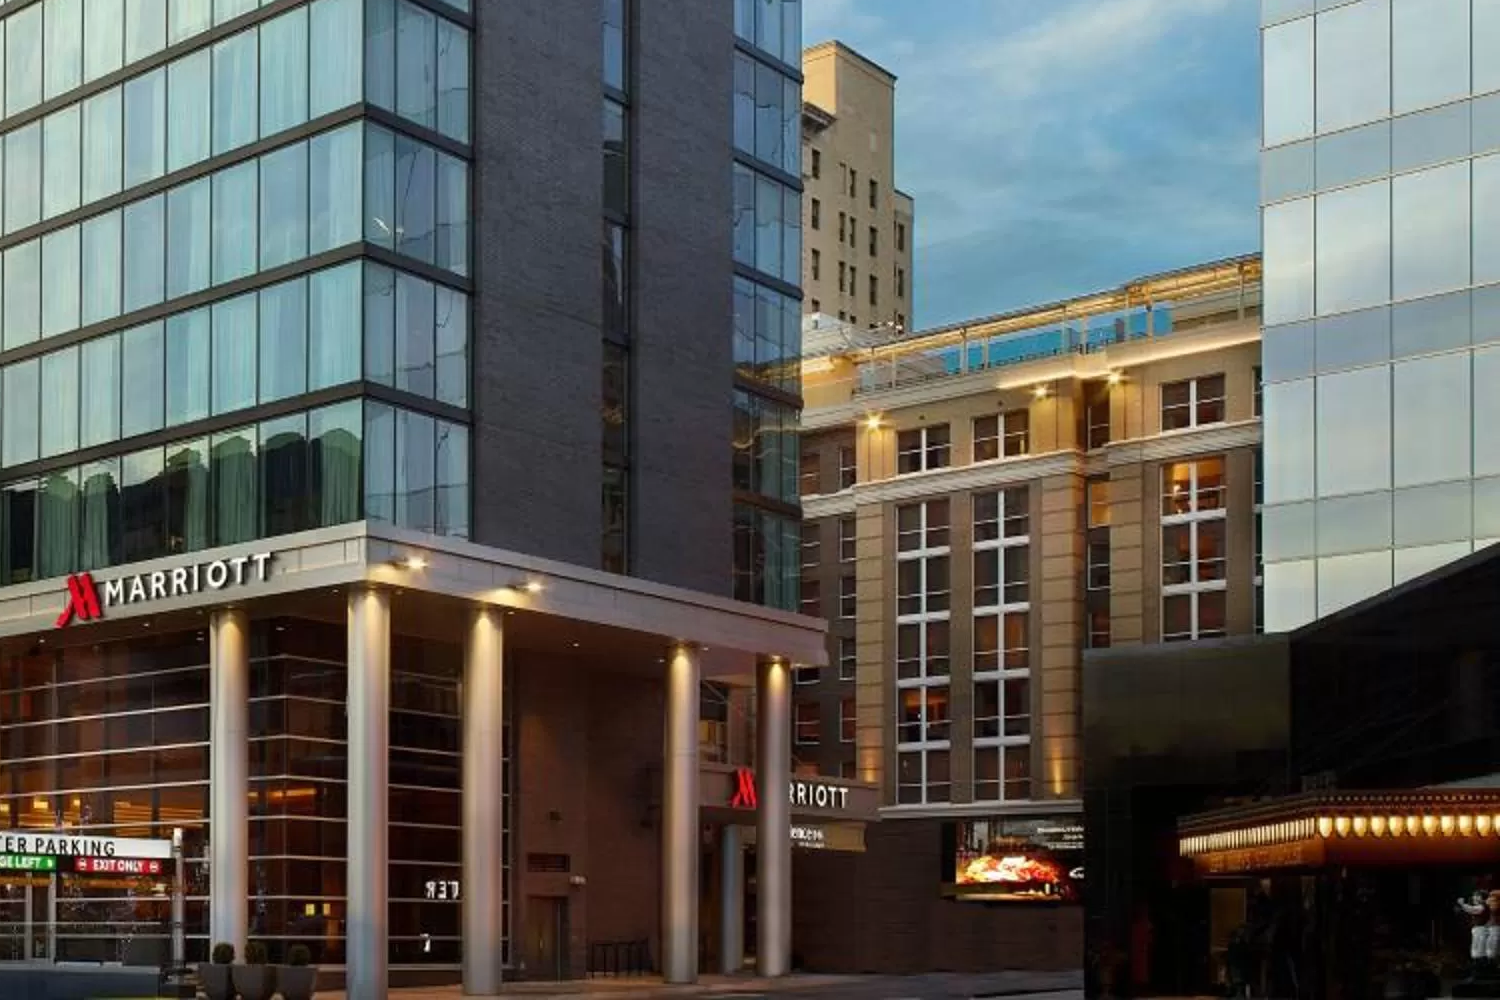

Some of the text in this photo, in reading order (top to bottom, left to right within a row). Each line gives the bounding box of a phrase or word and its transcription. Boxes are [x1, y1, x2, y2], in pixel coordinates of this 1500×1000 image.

[105, 552, 273, 606] MARRIOTT
[35, 838, 115, 856] PARKING
[15, 855, 41, 869] LEFT
[92, 859, 144, 872] EXIT ONLY
